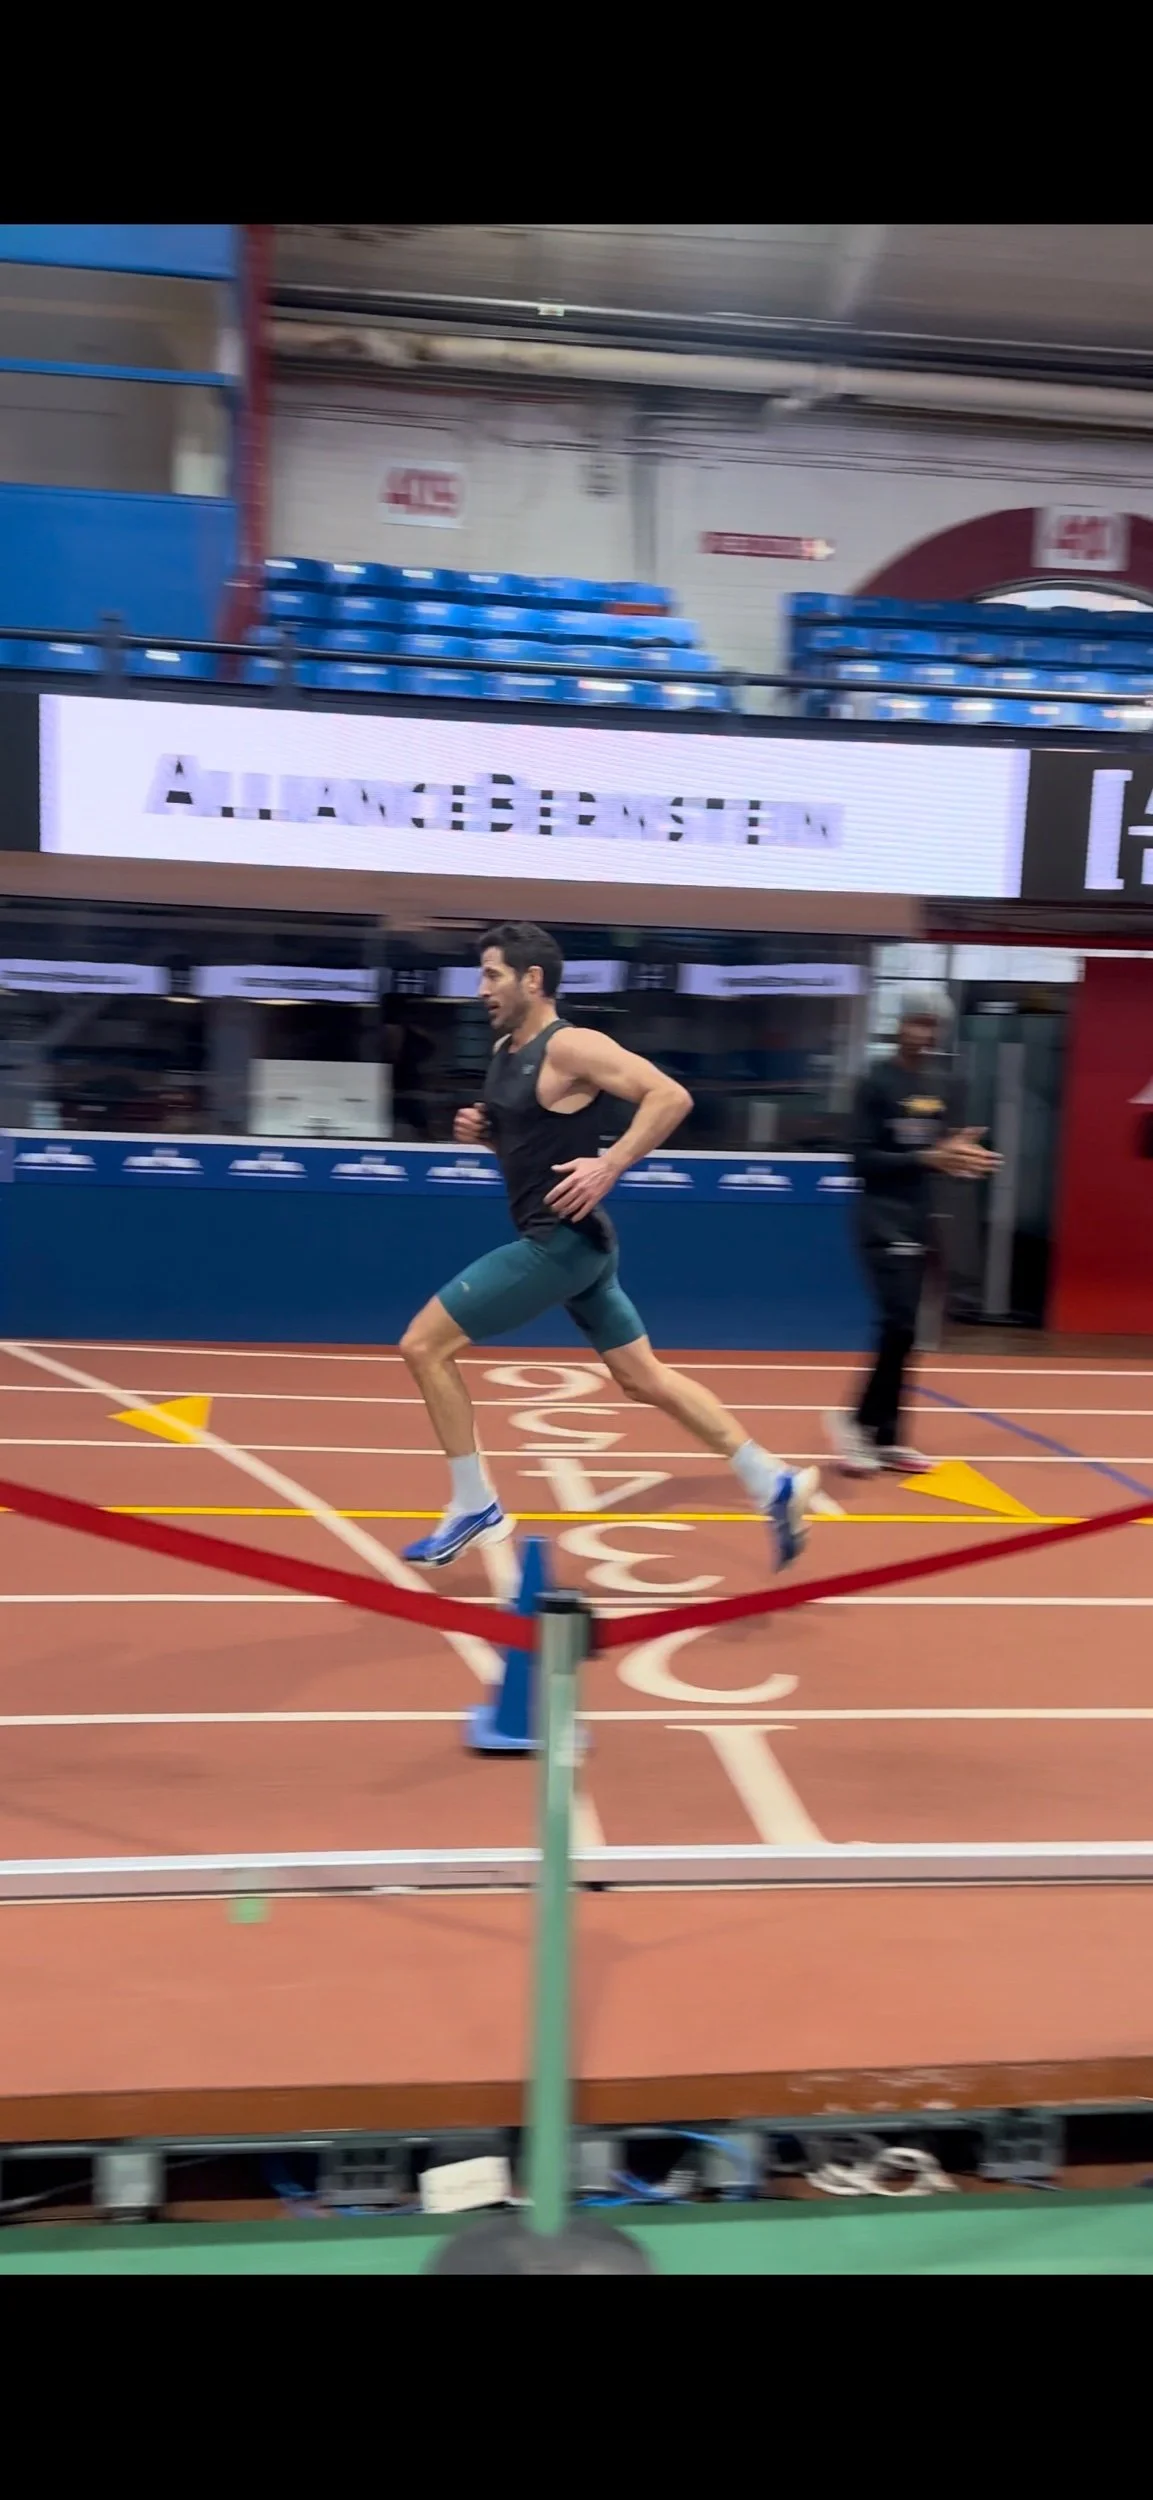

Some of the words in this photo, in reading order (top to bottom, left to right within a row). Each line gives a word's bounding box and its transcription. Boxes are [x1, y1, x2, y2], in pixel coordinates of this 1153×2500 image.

[482, 1365, 606, 1401] 6
[508, 1407, 627, 1450] 5
[516, 1457, 673, 1512] 4
[557, 1521, 725, 1593] 3
[664, 1725, 860, 1846] 1
